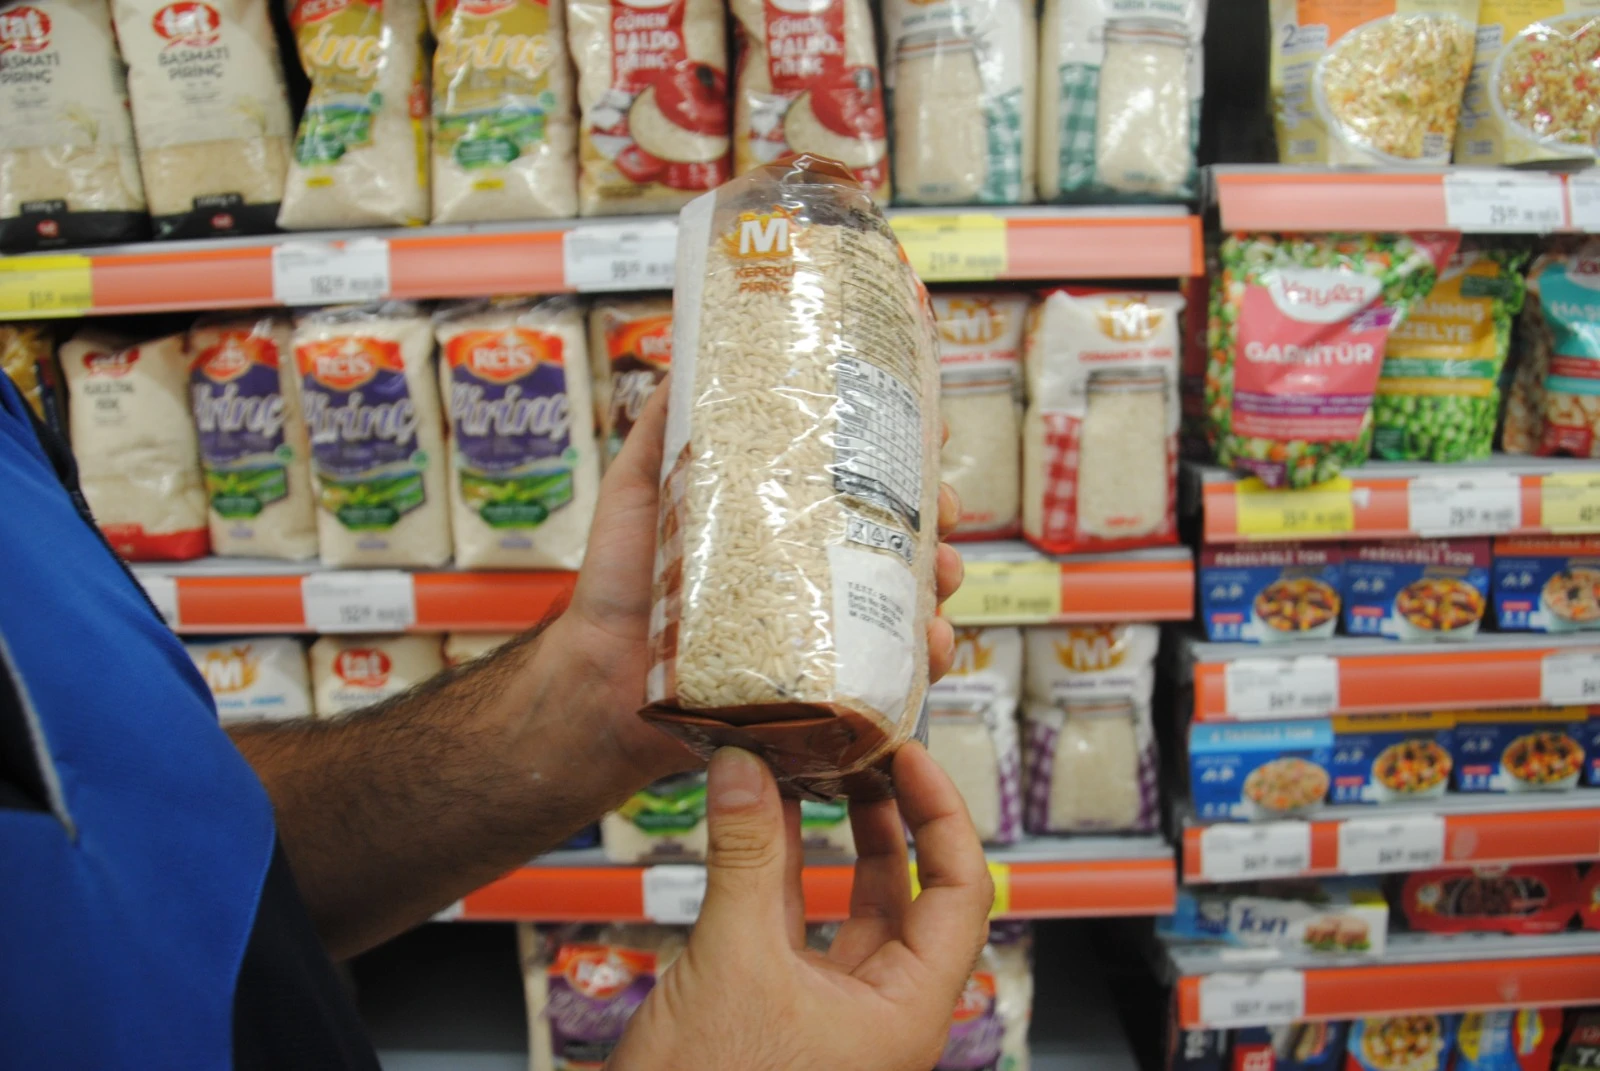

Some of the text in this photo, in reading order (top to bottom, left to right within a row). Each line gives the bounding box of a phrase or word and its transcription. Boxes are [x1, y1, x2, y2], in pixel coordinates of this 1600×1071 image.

[162, 5, 211, 34] tat
[614, 31, 680, 51] BALDO
[739, 217, 789, 255] M
[340, 650, 383, 680] tat
